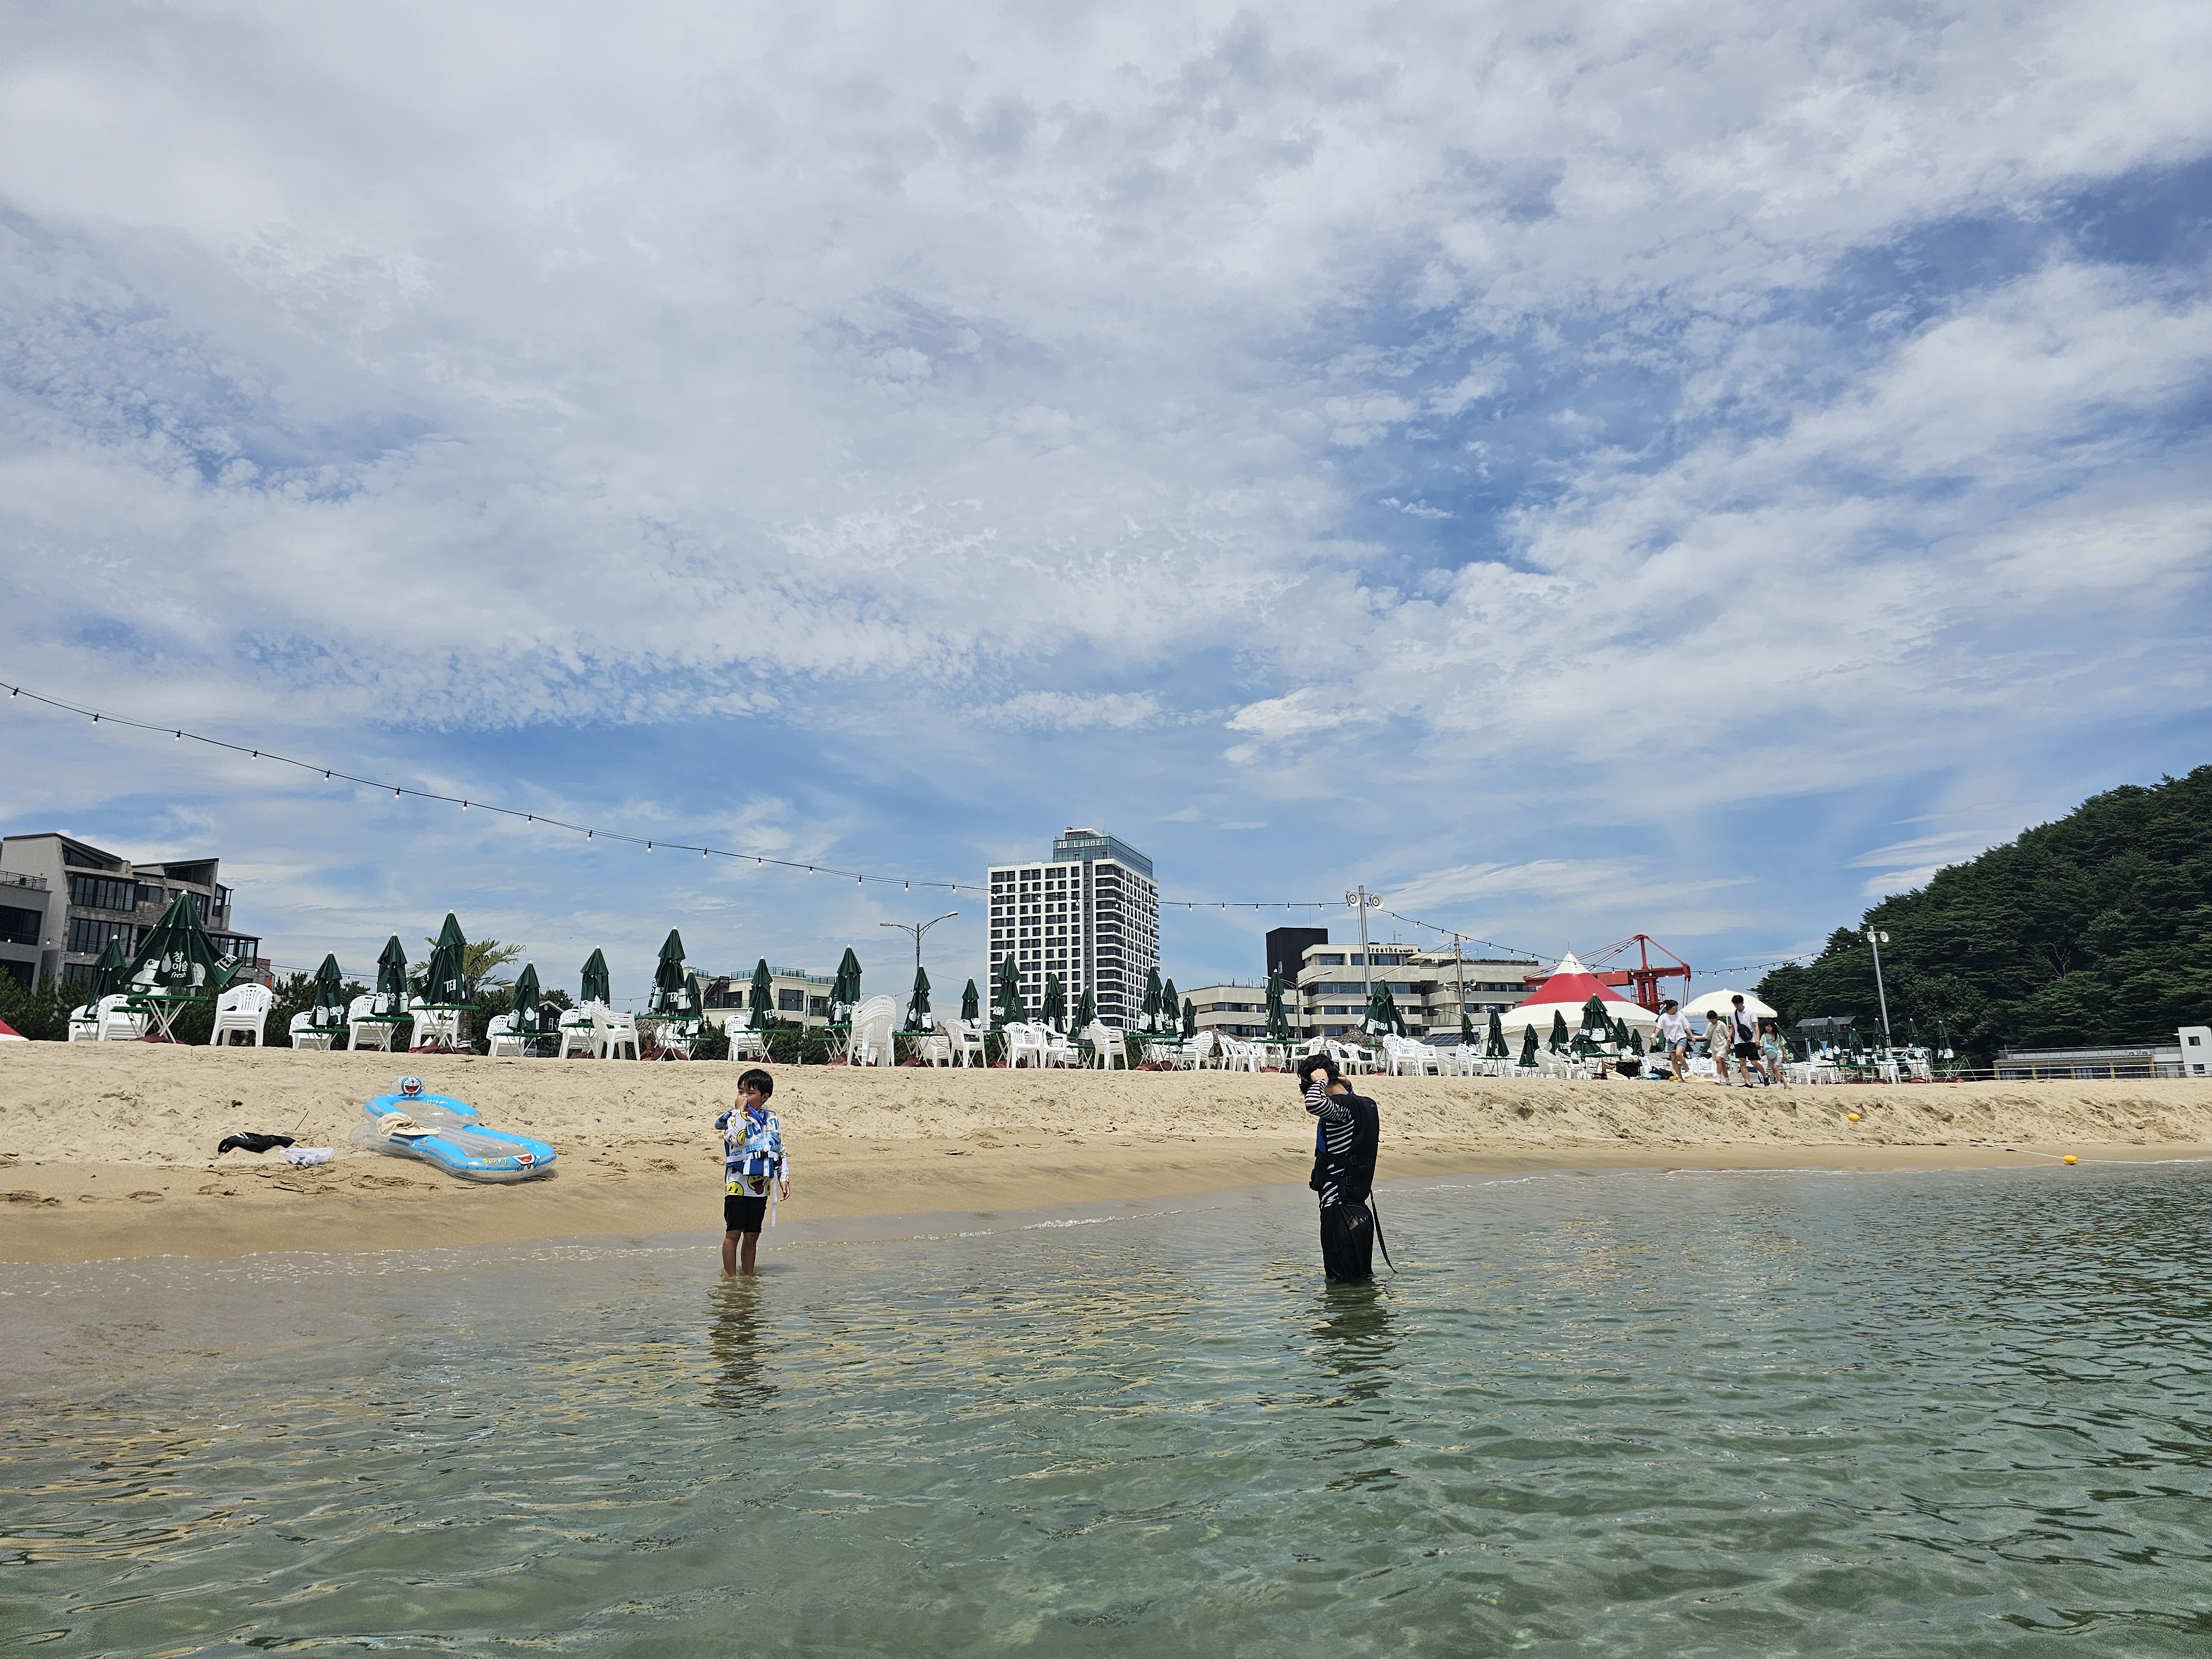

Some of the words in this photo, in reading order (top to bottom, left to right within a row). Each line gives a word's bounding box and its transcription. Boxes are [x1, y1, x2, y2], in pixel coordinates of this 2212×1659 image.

[1073, 838, 1104, 848] Launzi
[173, 951, 184, 962] 참
[172, 961, 188, 972] 이슬
[667, 992, 678, 1003] TER
[993, 1006, 1005, 1017] RRA
